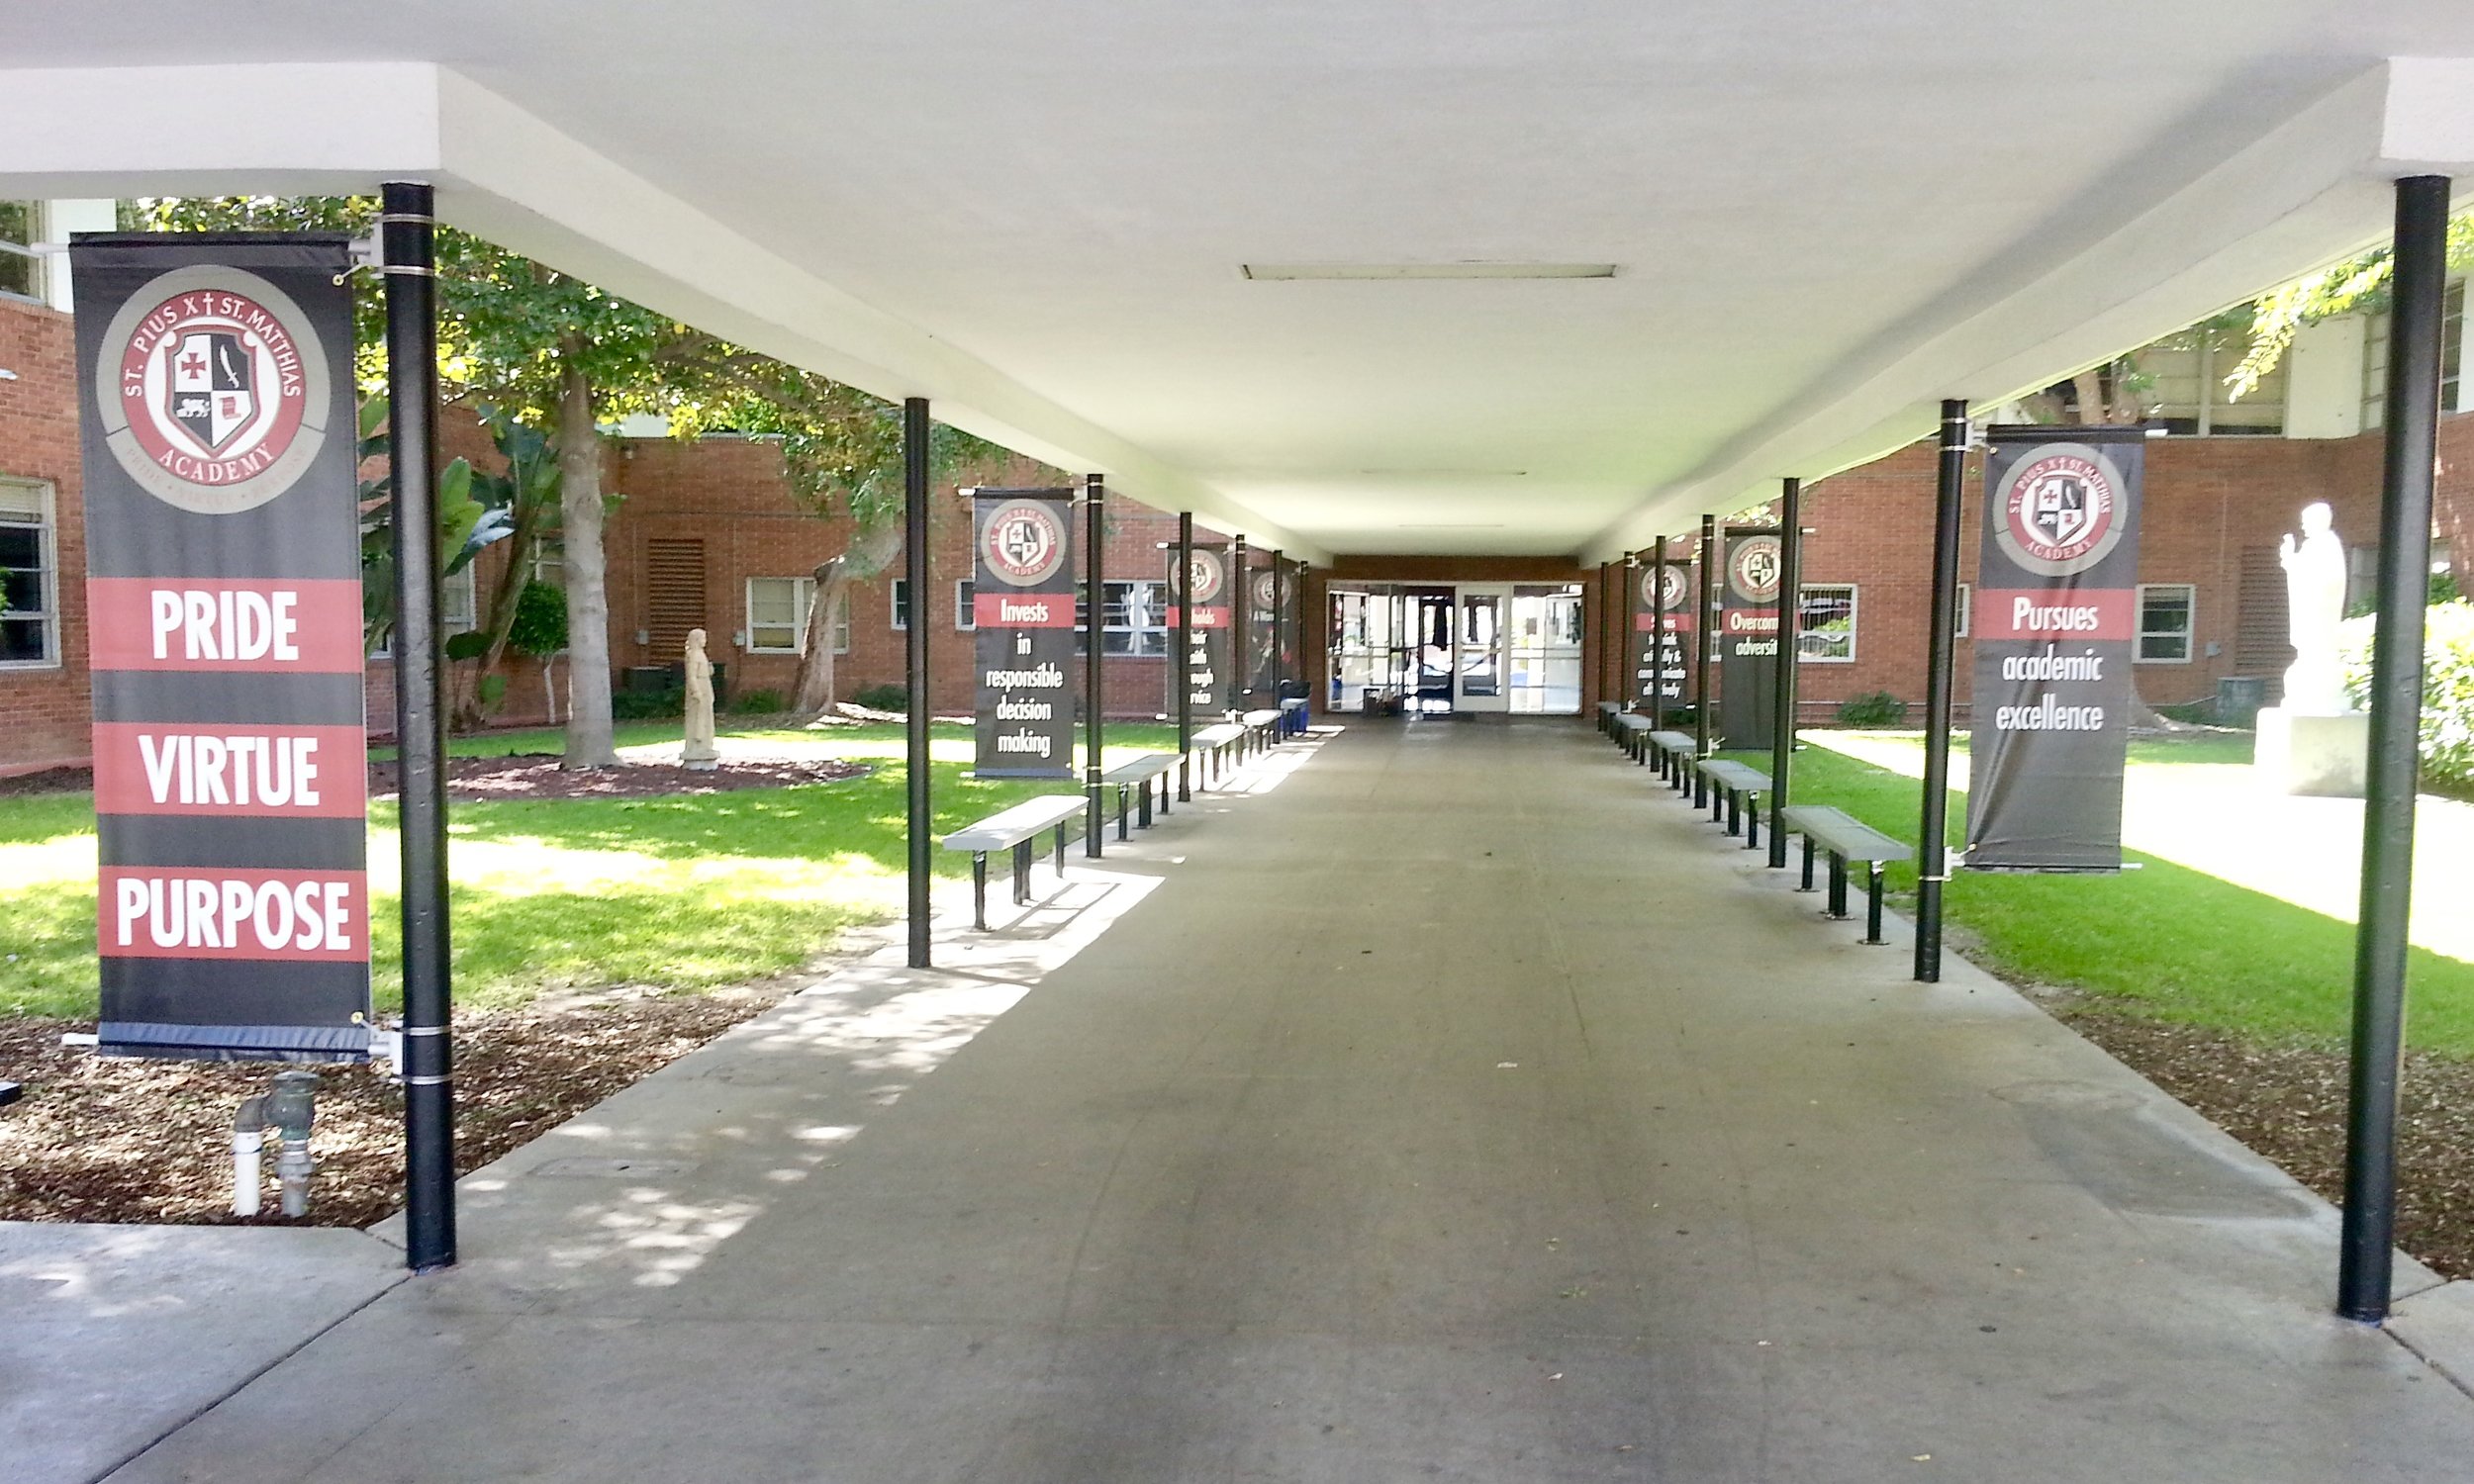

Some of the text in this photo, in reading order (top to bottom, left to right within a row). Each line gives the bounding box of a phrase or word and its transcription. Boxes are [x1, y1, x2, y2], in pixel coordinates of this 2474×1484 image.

[125, 297, 301, 398] ST. PIUS X ST. MATTHIAS
[159, 442, 275, 484] ACADEMY
[150, 590, 299, 662] PRIDE
[1000, 599, 1049, 622] Invests
[1730, 611, 1779, 631] Overcom
[2012, 596, 2099, 631] Pursues
[1016, 633, 1031, 655] in
[1736, 635, 1778, 656] adversit
[986, 662, 1063, 693] responsible
[2002, 643, 2104, 682] academic
[997, 695, 1052, 720] decision
[1995, 693, 2105, 732] excellence
[998, 727, 1051, 759] making
[138, 734, 320, 806] VIRTUE
[116, 878, 351, 951] PURPOSE
